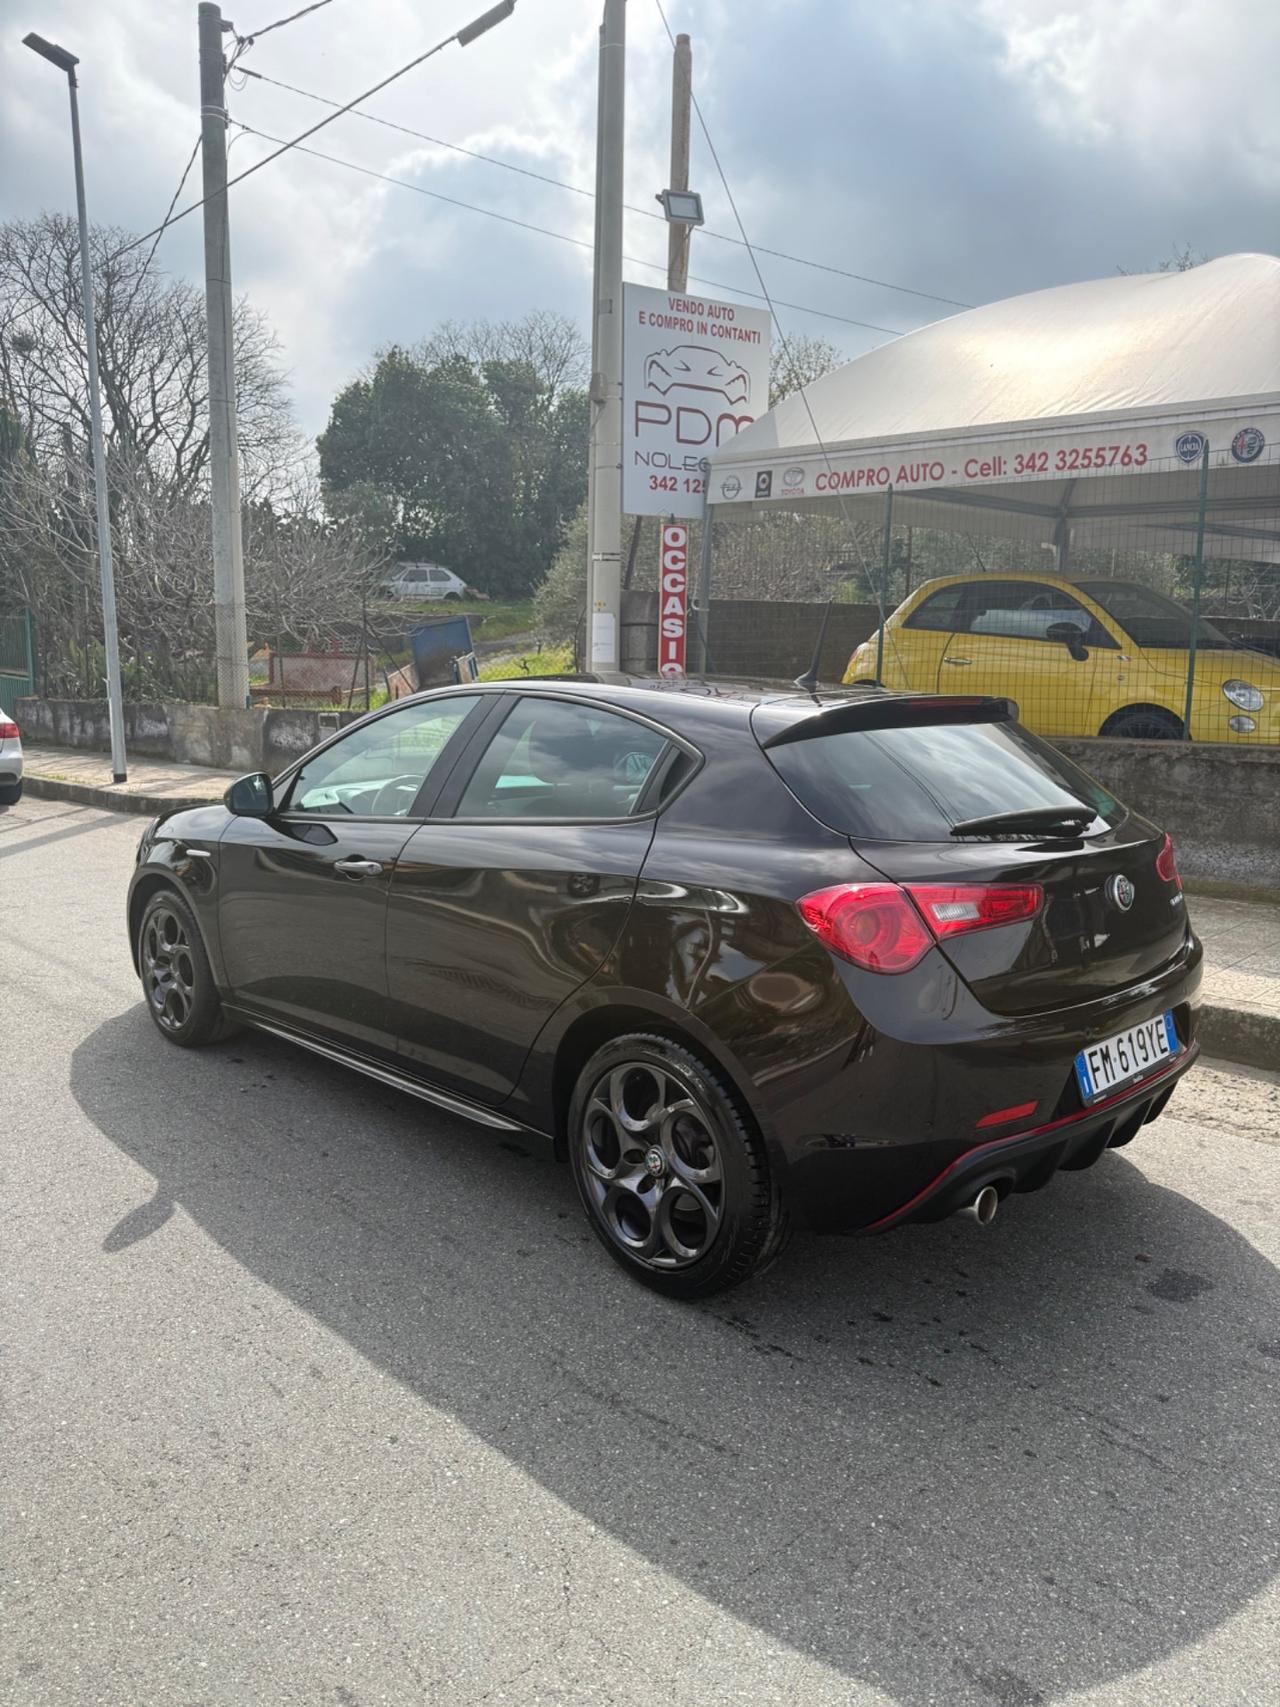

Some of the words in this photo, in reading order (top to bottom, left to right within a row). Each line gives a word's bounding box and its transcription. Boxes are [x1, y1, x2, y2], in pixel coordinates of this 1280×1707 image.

[669, 297, 704, 316] VENDO
[708, 305, 735, 321] AUTO
[639, 311, 646, 325] E
[649, 312, 694, 333] COMPRO
[697, 321, 708, 335] IN
[711, 324, 761, 344] CONTANTI
[815, 466, 890, 491] COMPRO
[896, 461, 945, 484] AUTO
[964, 456, 1008, 478] Cell:
[1013, 451, 1049, 474] 342
[1055, 443, 1148, 471] 3255763
[649, 475, 678, 492] 342
[683, 478, 705, 494] 12
